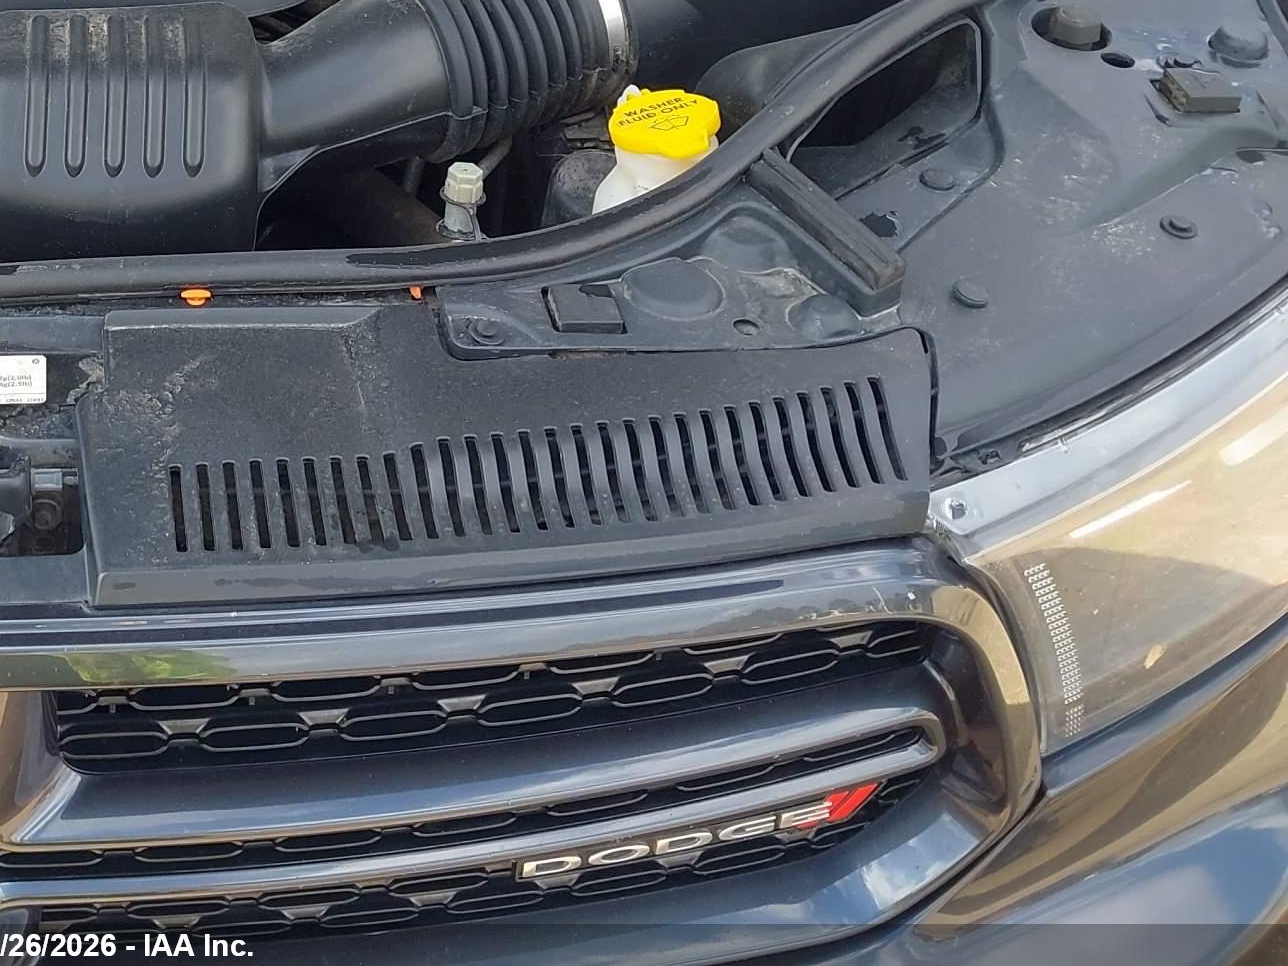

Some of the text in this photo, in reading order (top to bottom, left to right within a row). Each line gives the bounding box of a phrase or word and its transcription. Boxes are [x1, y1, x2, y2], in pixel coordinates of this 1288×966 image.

[618, 99, 698, 127] FLUID ONLY
[623, 97, 684, 117] WASHER
[521, 800, 833, 878] DODGE
